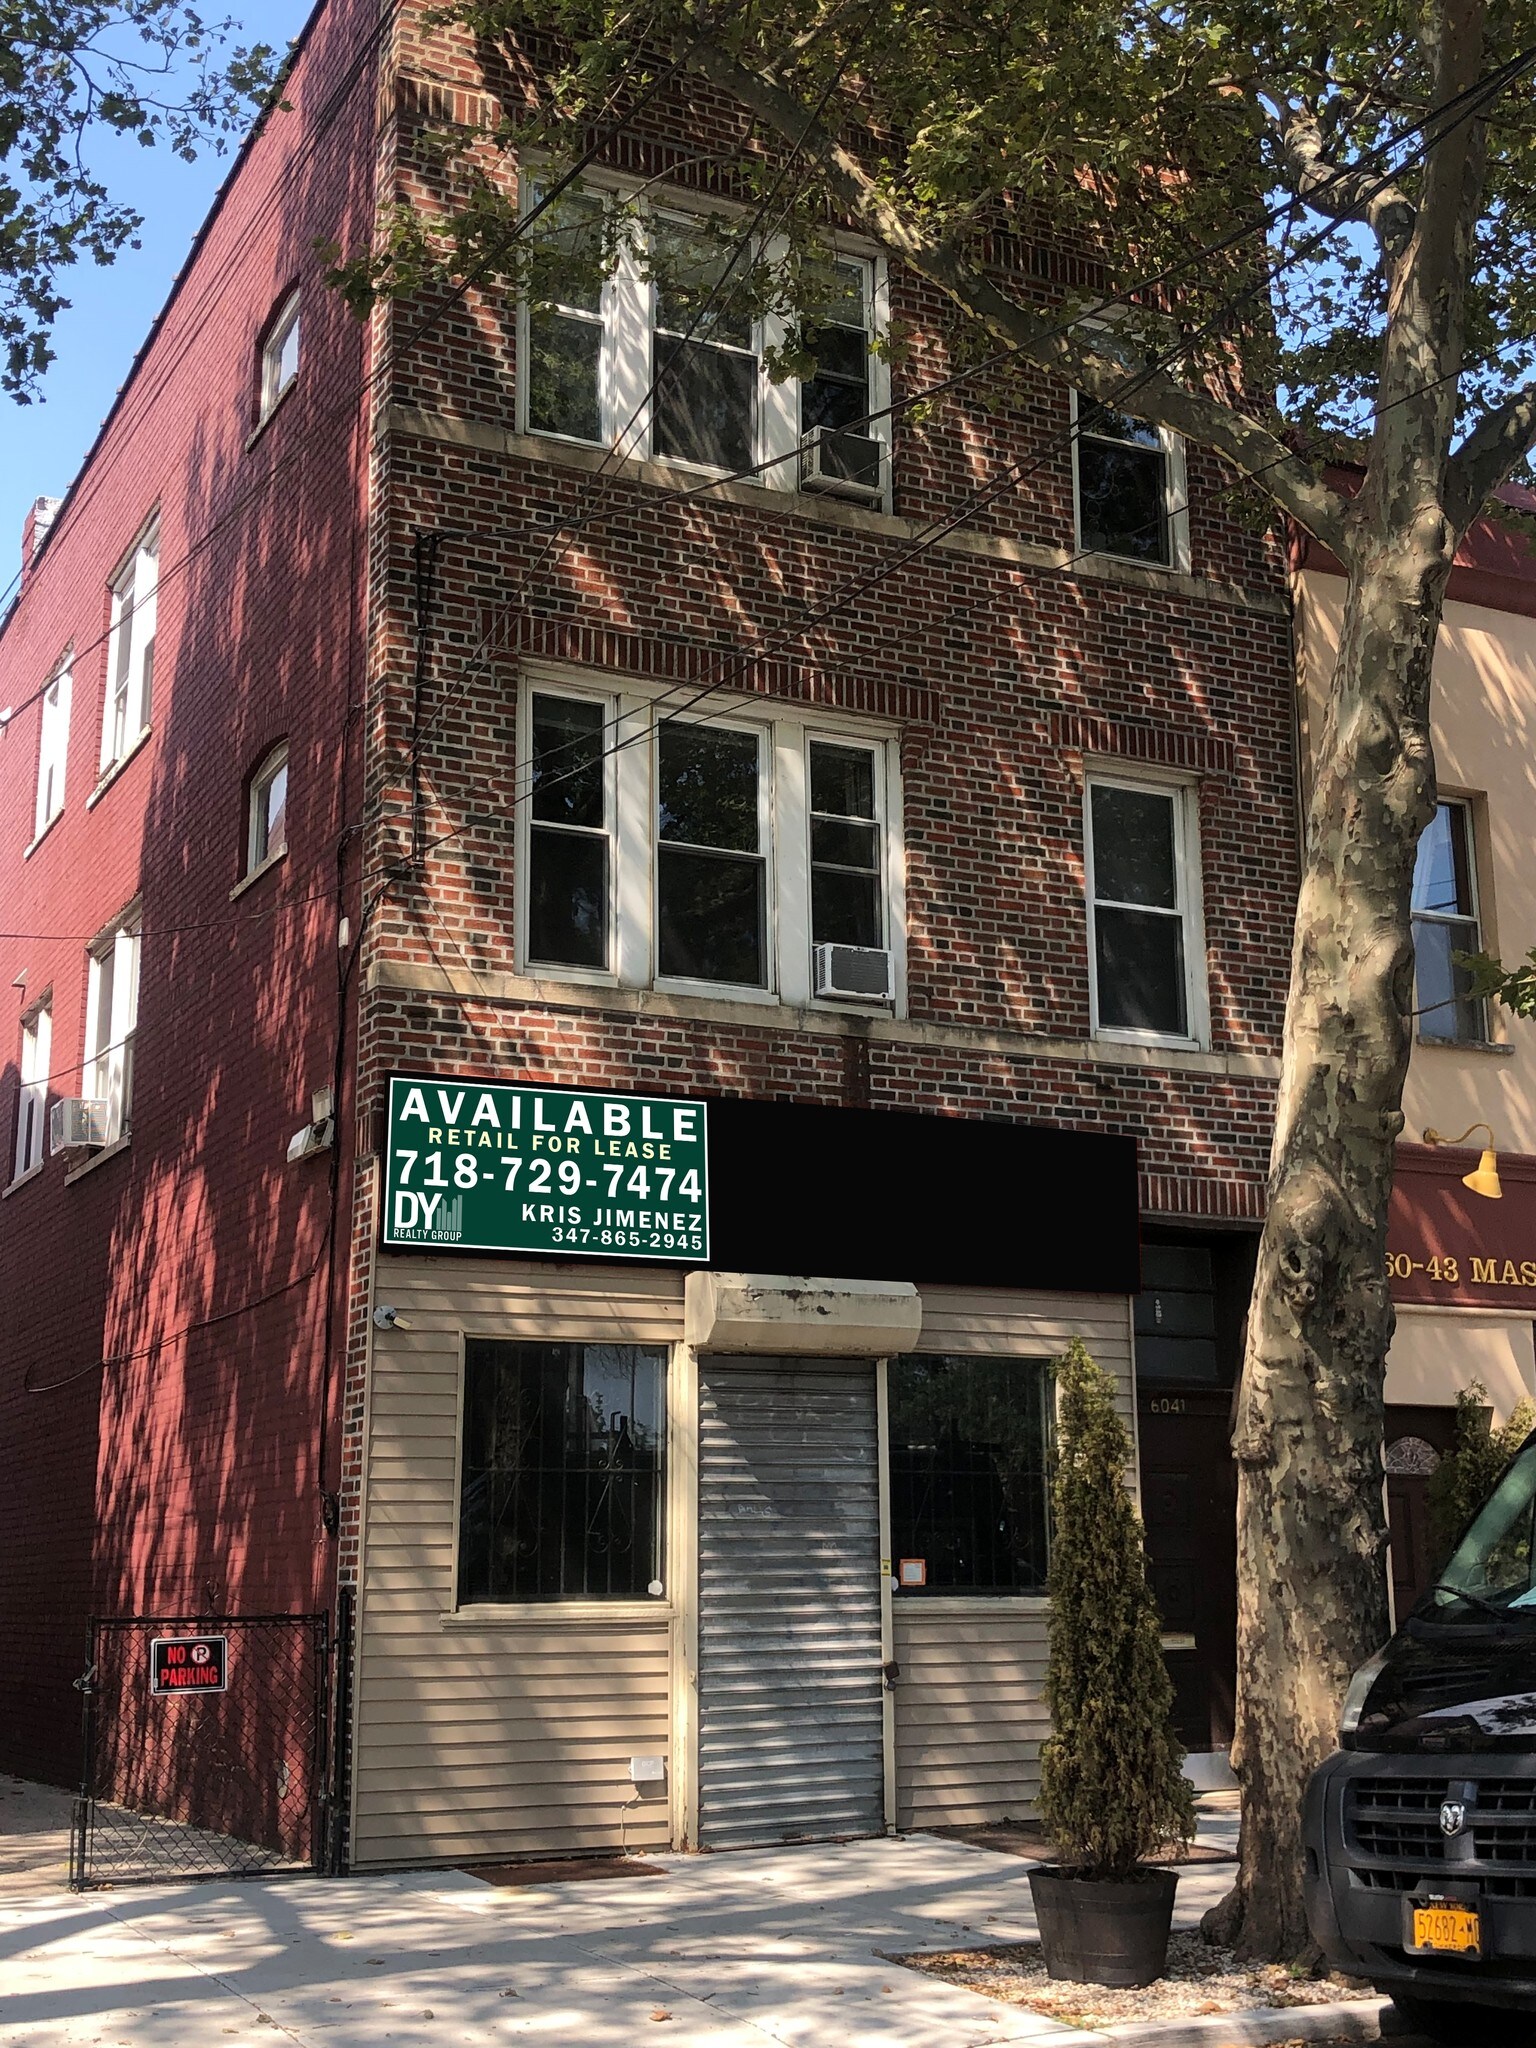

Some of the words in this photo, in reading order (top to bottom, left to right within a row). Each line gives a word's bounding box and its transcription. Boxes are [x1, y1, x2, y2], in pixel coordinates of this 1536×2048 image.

[400, 1088, 697, 1142] AVAILABLE
[428, 1127, 518, 1150] RETAIL
[532, 1135, 580, 1154] FOR
[594, 1139, 671, 1160] LEASE
[395, 1149, 702, 1203] 718-729-7474
[394, 1190, 443, 1230] DY
[522, 1203, 581, 1225] KRIS
[593, 1208, 702, 1231] JIMENEZ
[393, 1228, 428, 1239] REALTY
[431, 1230, 462, 1242] GROUP
[552, 1226, 702, 1250] 347-865-2945
[1469, 1257, 1536, 1287] MAS
[1150, 1398, 1186, 1414] 6041
[168, 1646, 186, 1664] NO
[161, 1666, 218, 1686] PARKING
[1419, 1912, 1457, 1942] 52682
